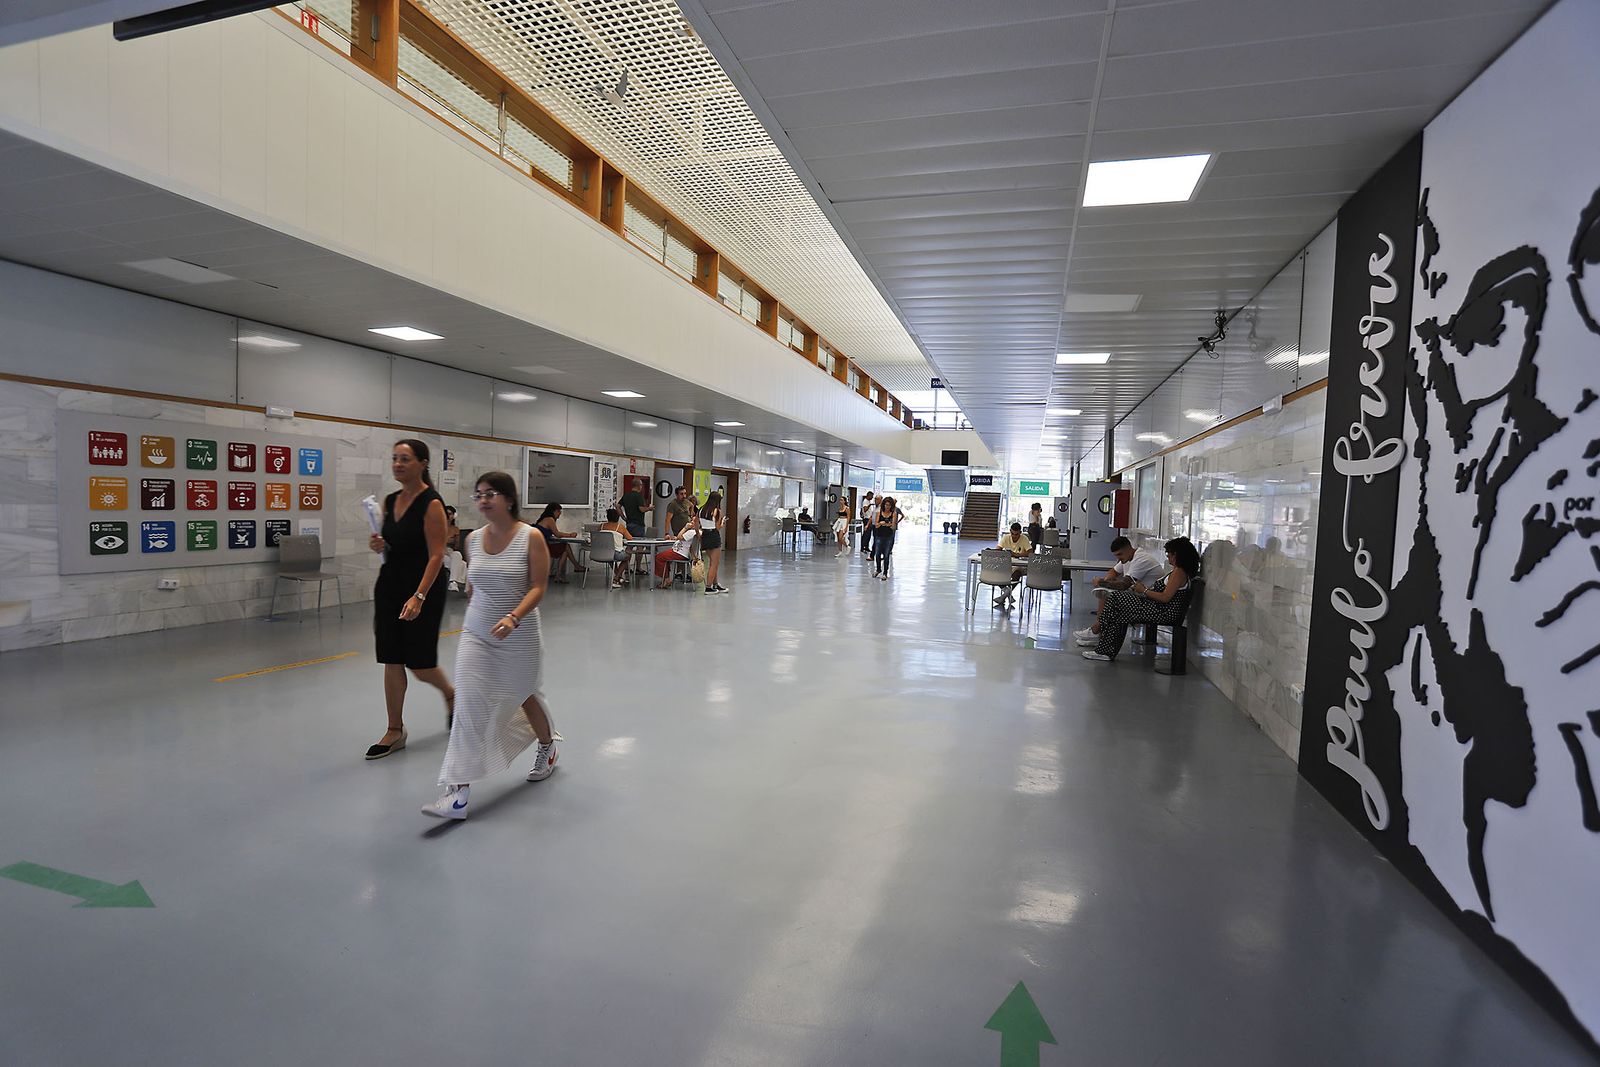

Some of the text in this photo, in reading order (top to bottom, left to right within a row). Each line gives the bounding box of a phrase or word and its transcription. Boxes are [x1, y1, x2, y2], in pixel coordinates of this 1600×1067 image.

[90, 433, 95, 441] 1
[142, 437, 148, 445] 2
[188, 440, 193, 448] 3
[91, 479, 96, 487] 7
[142, 480, 148, 488] 8
[1564, 496, 1595, 520] por
[91, 523, 100, 532] 13
[142, 523, 151, 531] 14
[188, 522, 195, 530] 15
